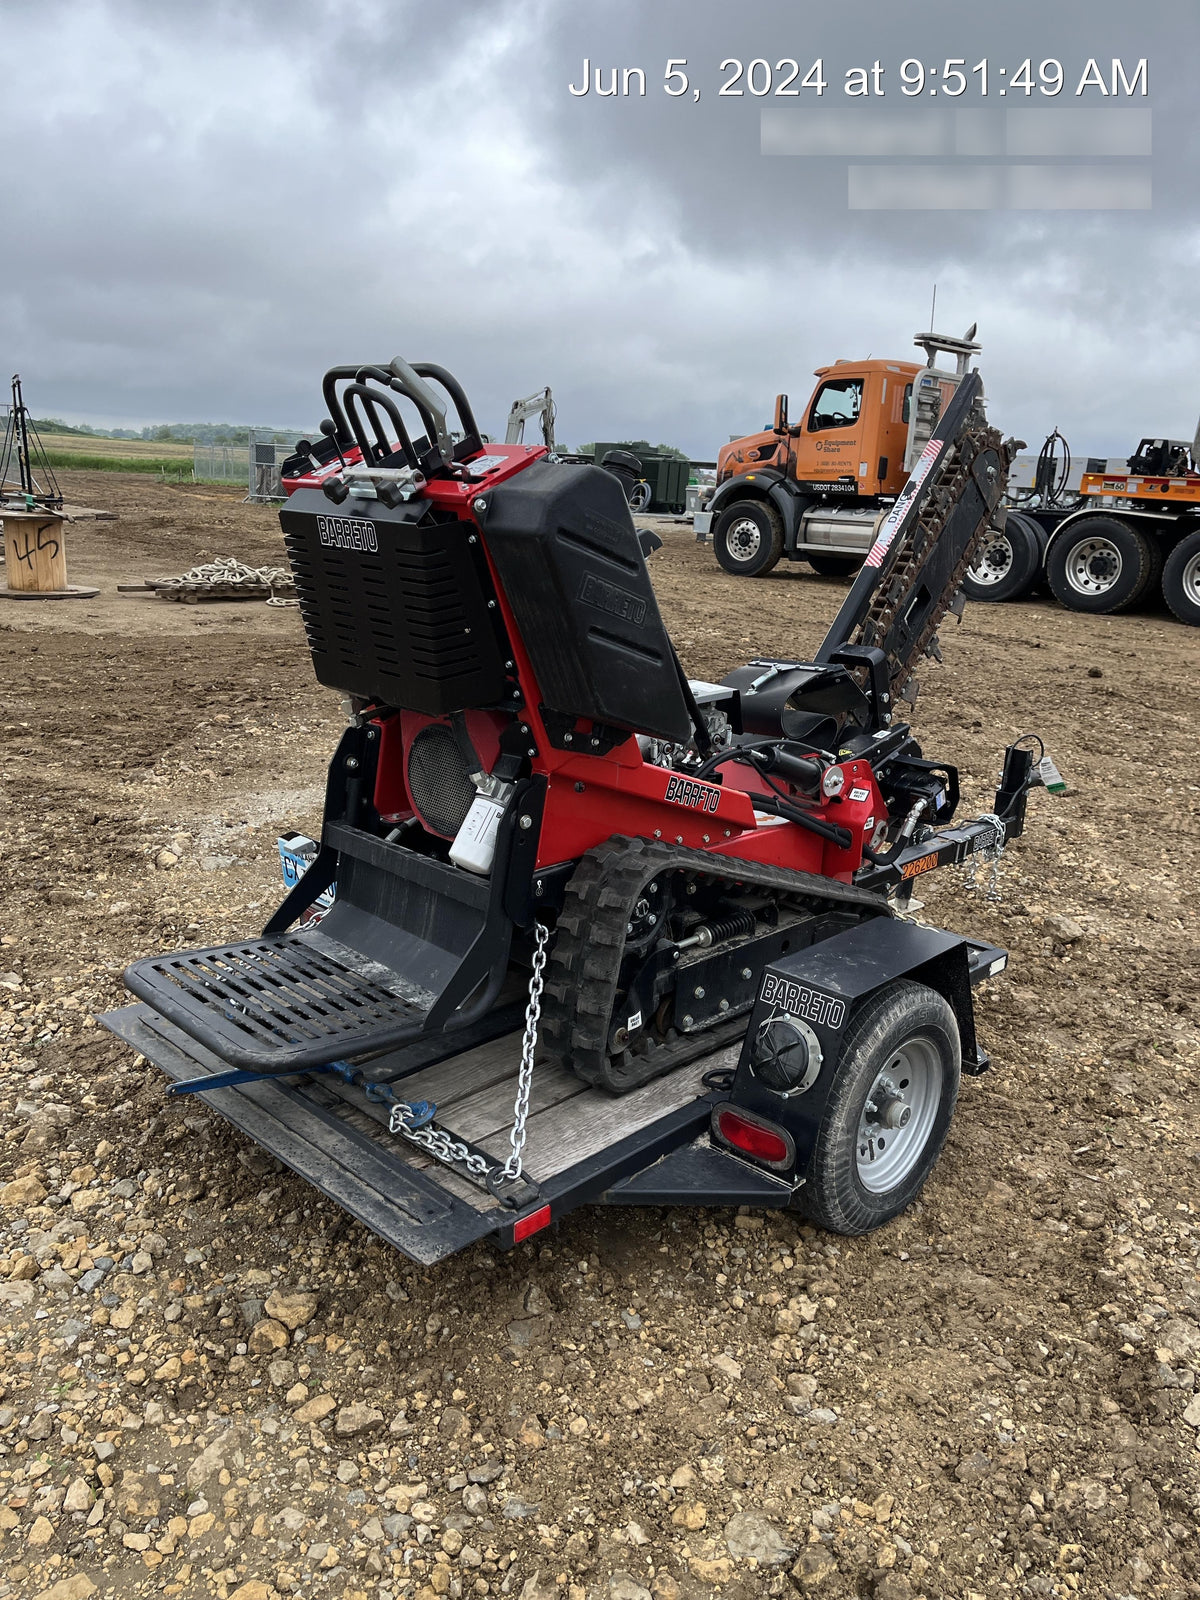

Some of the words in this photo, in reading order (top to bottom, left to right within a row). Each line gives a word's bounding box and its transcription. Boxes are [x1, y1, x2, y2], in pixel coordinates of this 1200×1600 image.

[812, 483, 831, 491] USDOT
[13, 523, 59, 570] 45
[316, 515, 378, 553] BARRETO
[902, 853, 939, 880] 226200
[760, 973, 846, 1030] BARRETO
